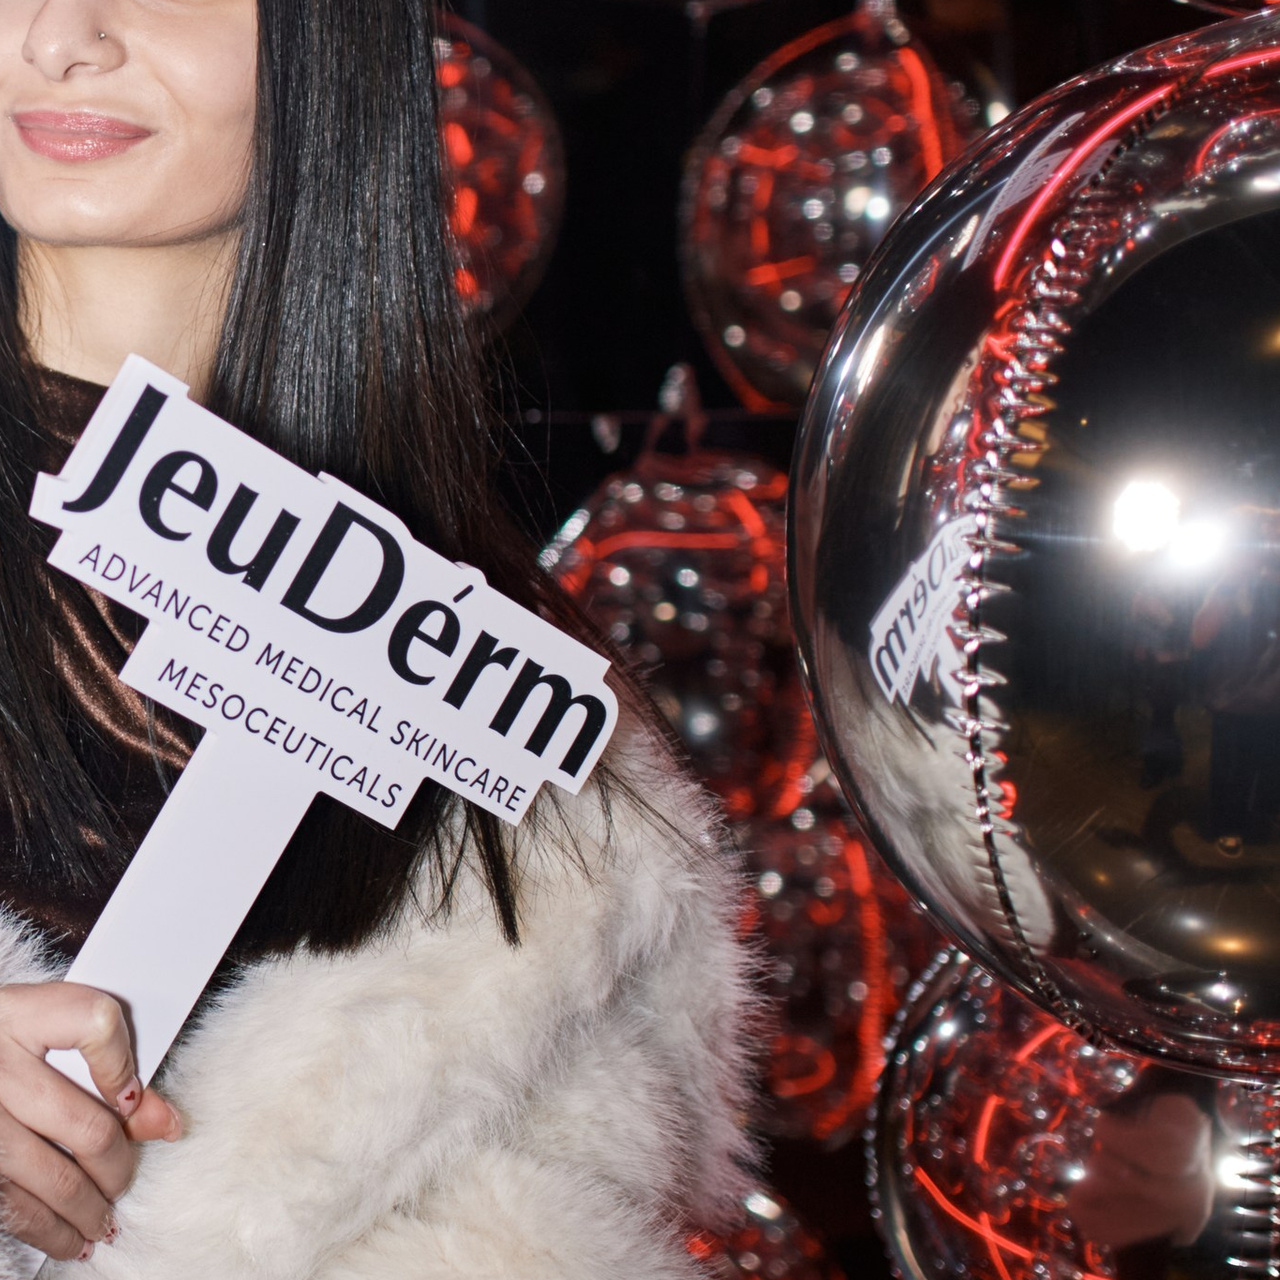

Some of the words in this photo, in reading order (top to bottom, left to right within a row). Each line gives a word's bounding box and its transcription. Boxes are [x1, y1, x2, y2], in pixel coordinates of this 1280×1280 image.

[62, 383, 608, 779] JeuDérm
[78, 544, 250, 653] ADVANCED
[255, 642, 382, 734] MEDICAL
[388, 720, 527, 812] SKINCARE
[157, 658, 403, 808] MESOCEUTICALS
